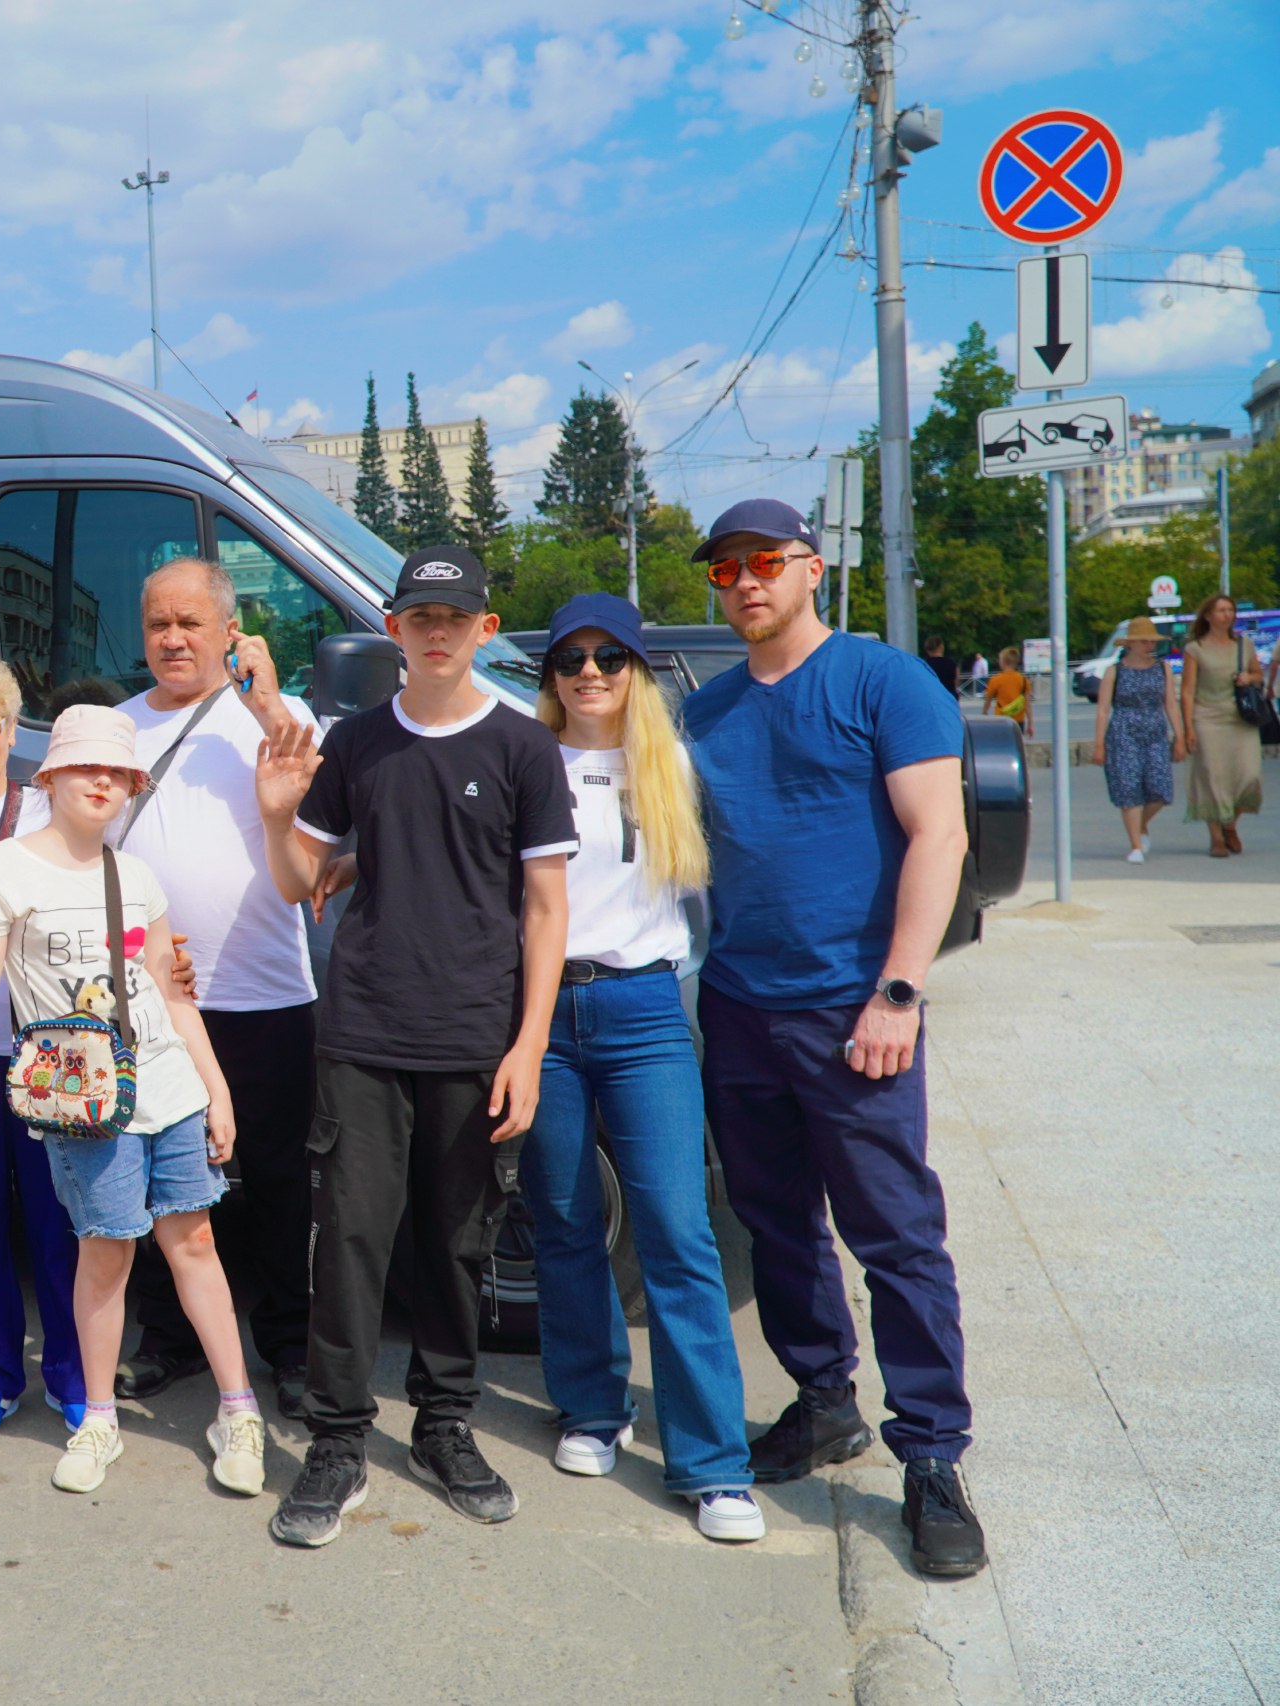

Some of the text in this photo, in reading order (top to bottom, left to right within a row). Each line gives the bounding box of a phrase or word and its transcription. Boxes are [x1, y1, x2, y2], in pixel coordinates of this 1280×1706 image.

[420, 563, 455, 577] Ford
[585, 776, 609, 785] LITTLE
[47, 929, 99, 967] BE
